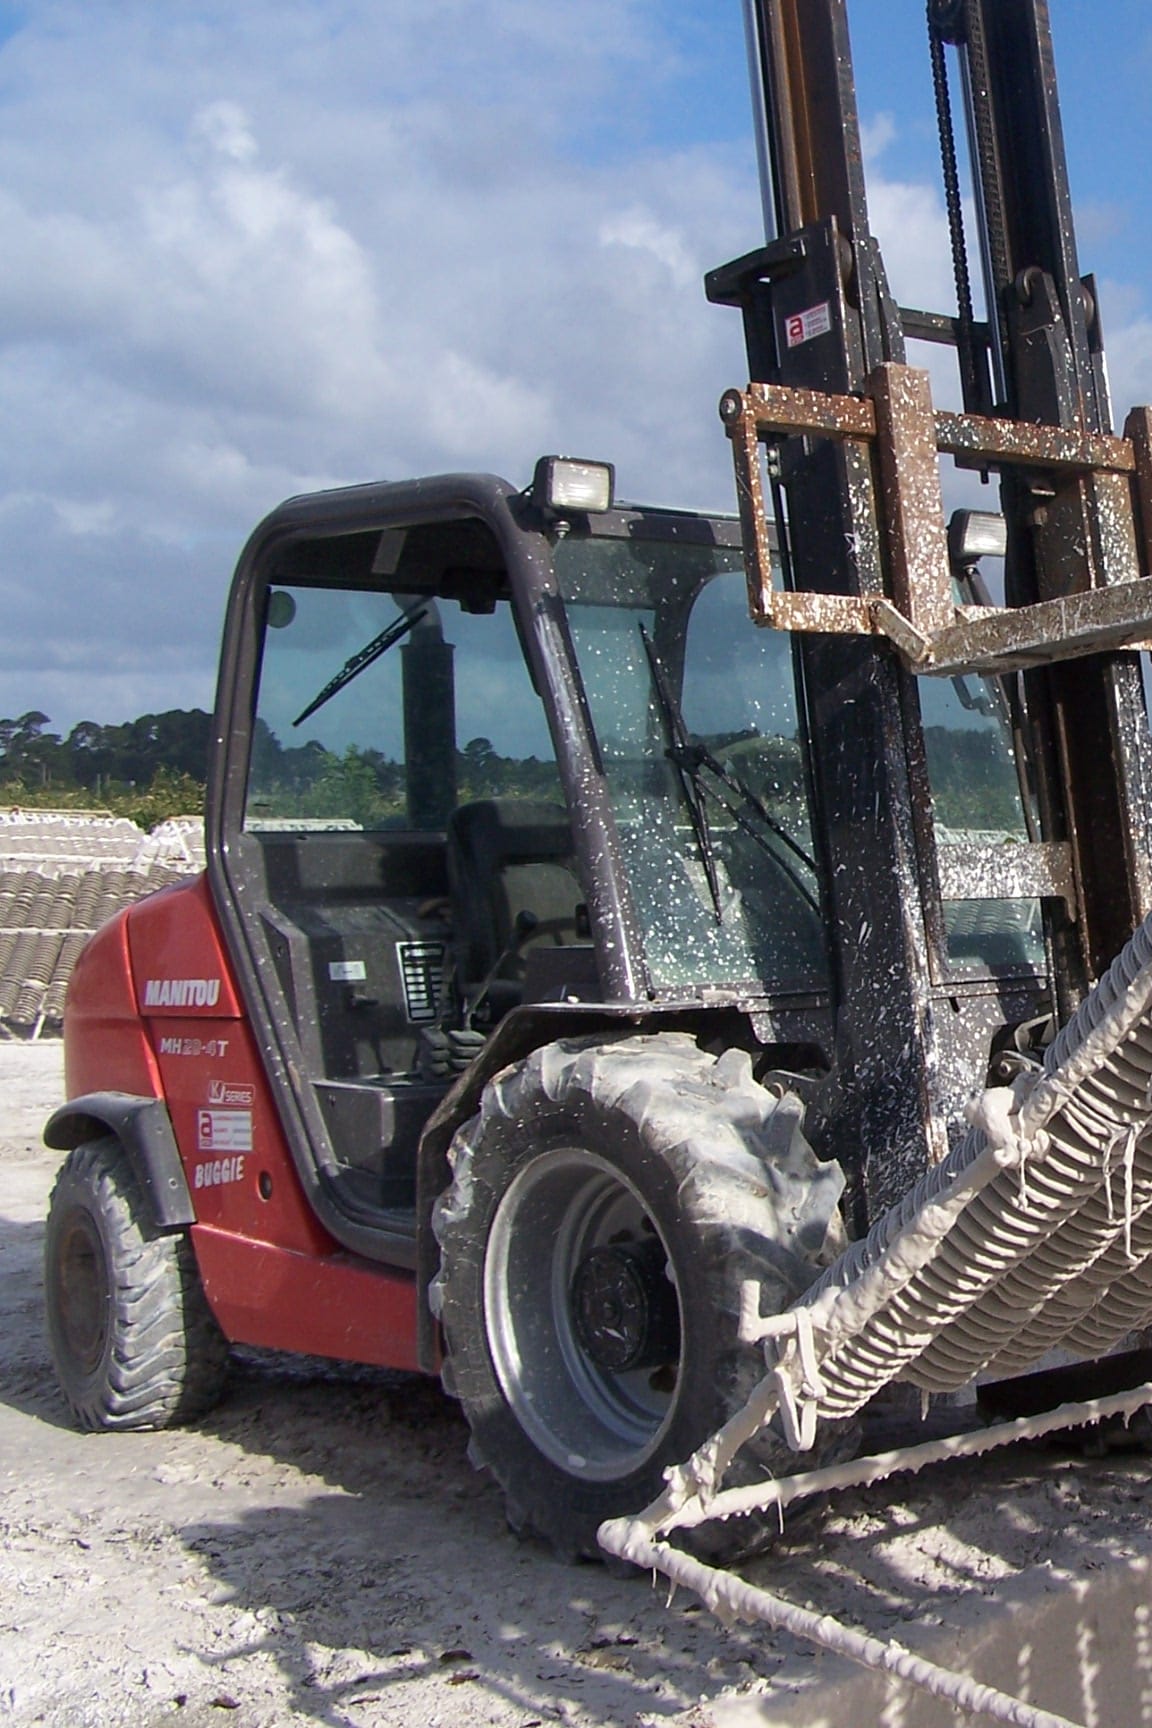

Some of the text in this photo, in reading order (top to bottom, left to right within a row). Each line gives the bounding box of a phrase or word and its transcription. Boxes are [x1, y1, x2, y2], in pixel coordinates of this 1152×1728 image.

[790, 317, 803, 337] a
[145, 979, 221, 1006] MANITOU
[201, 1112, 213, 1138] a
[194, 1156, 244, 1189] BUGGIE
